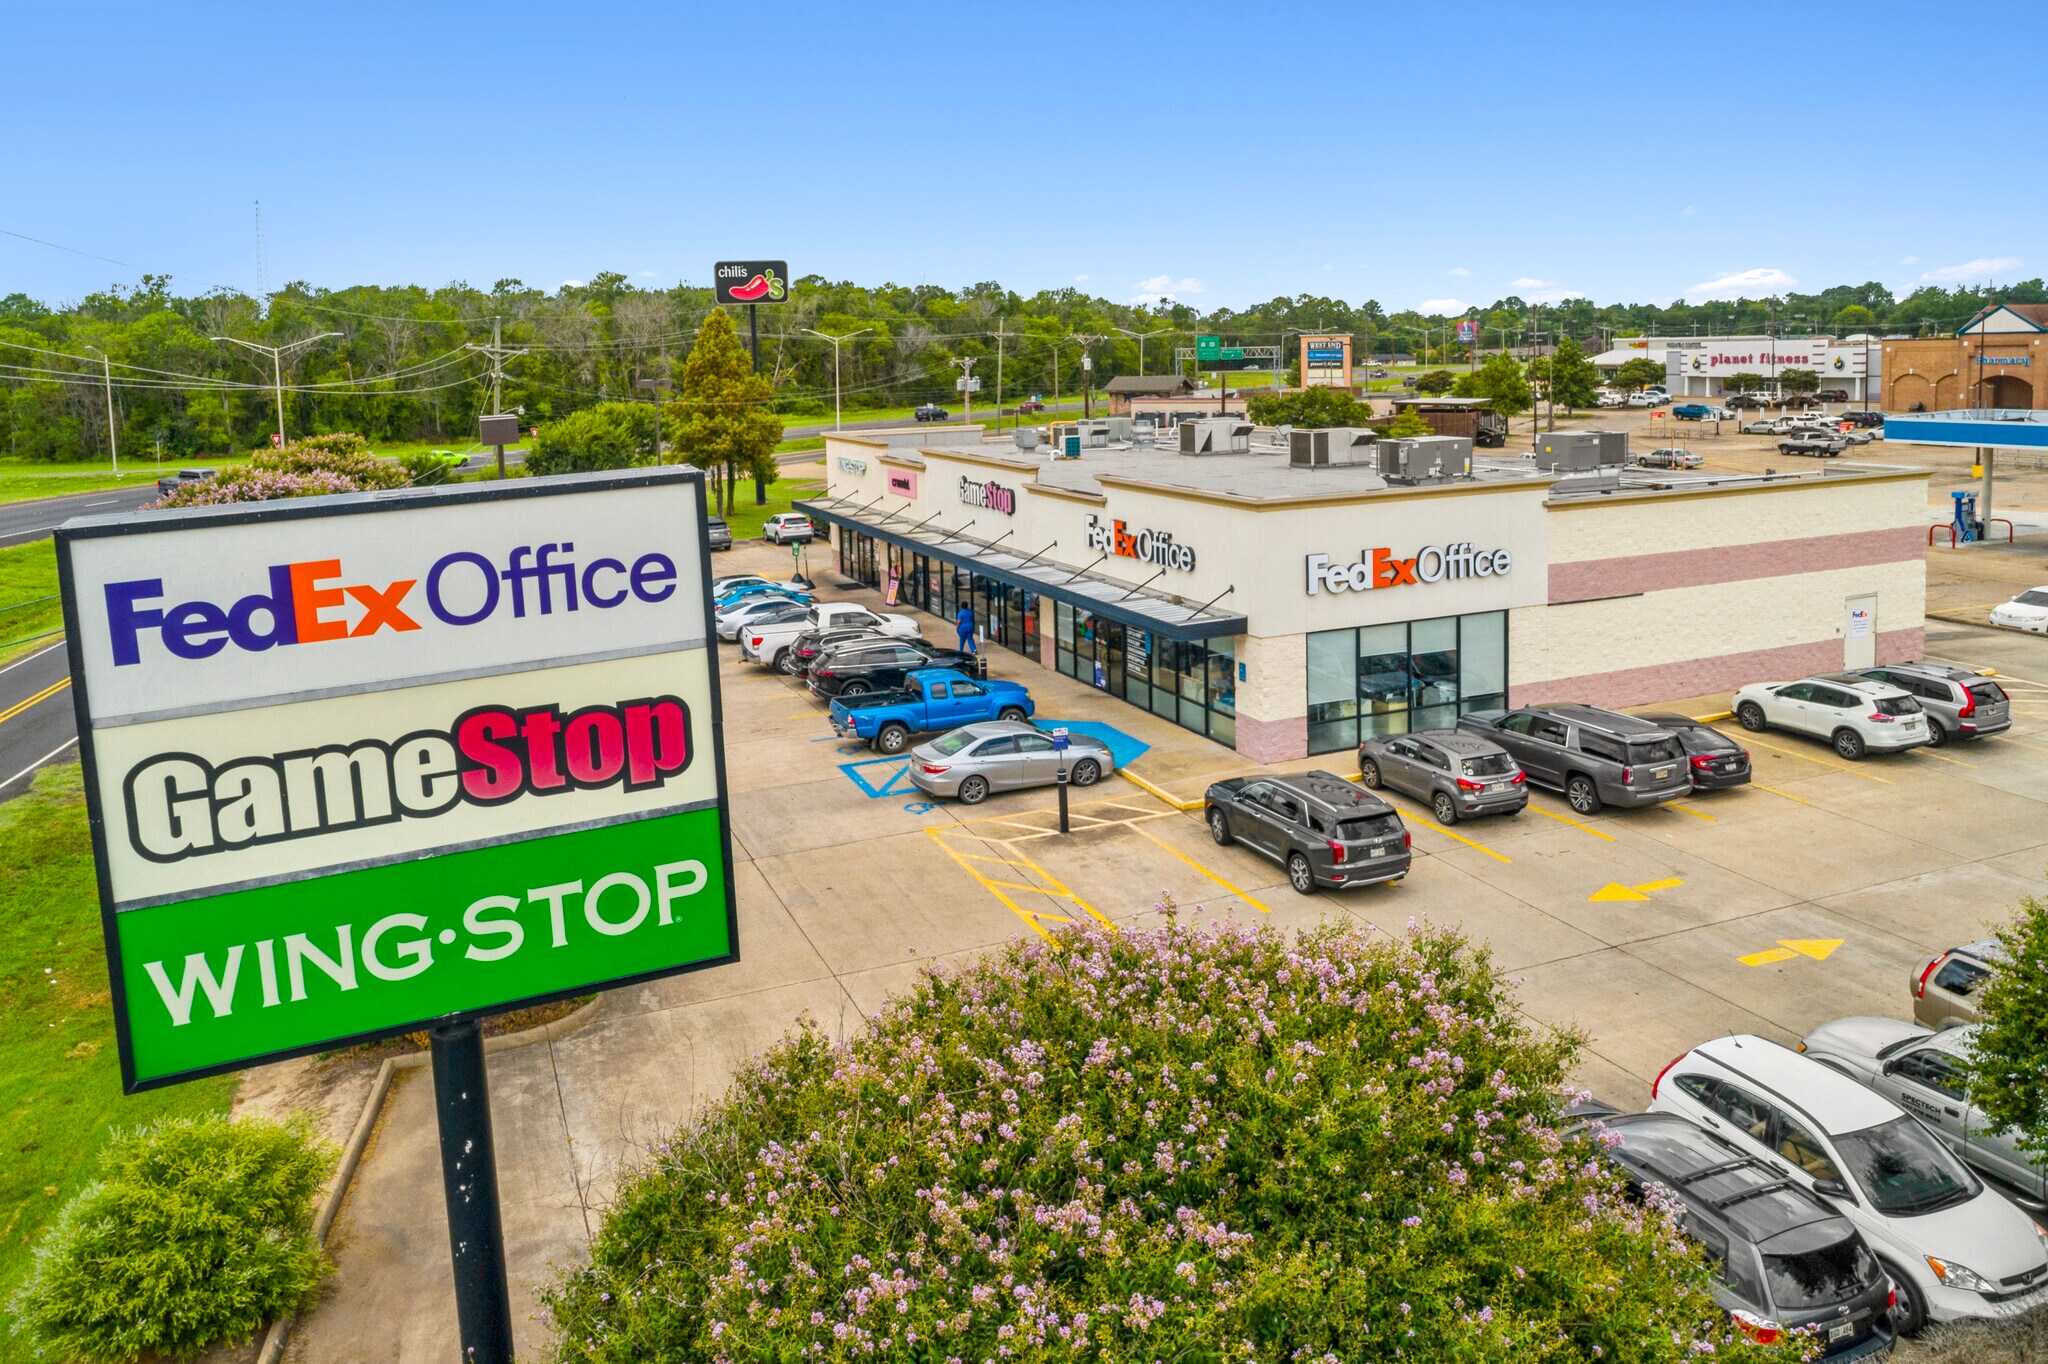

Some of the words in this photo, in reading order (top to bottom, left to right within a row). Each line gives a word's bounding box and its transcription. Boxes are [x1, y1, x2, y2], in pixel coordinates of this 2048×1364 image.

[1710, 353, 1754, 367] planet
[958, 475, 1016, 517] GameStop
[1084, 513, 1137, 559] FedEx
[1137, 528, 1197, 573] Office
[1305, 547, 1418, 596] FedEx
[1416, 542, 1512, 583] Office
[104, 558, 422, 667] FedEx
[425, 542, 678, 626] Office
[123, 695, 694, 863] GameStop
[1901, 1092, 1942, 1115] SPECTECH
